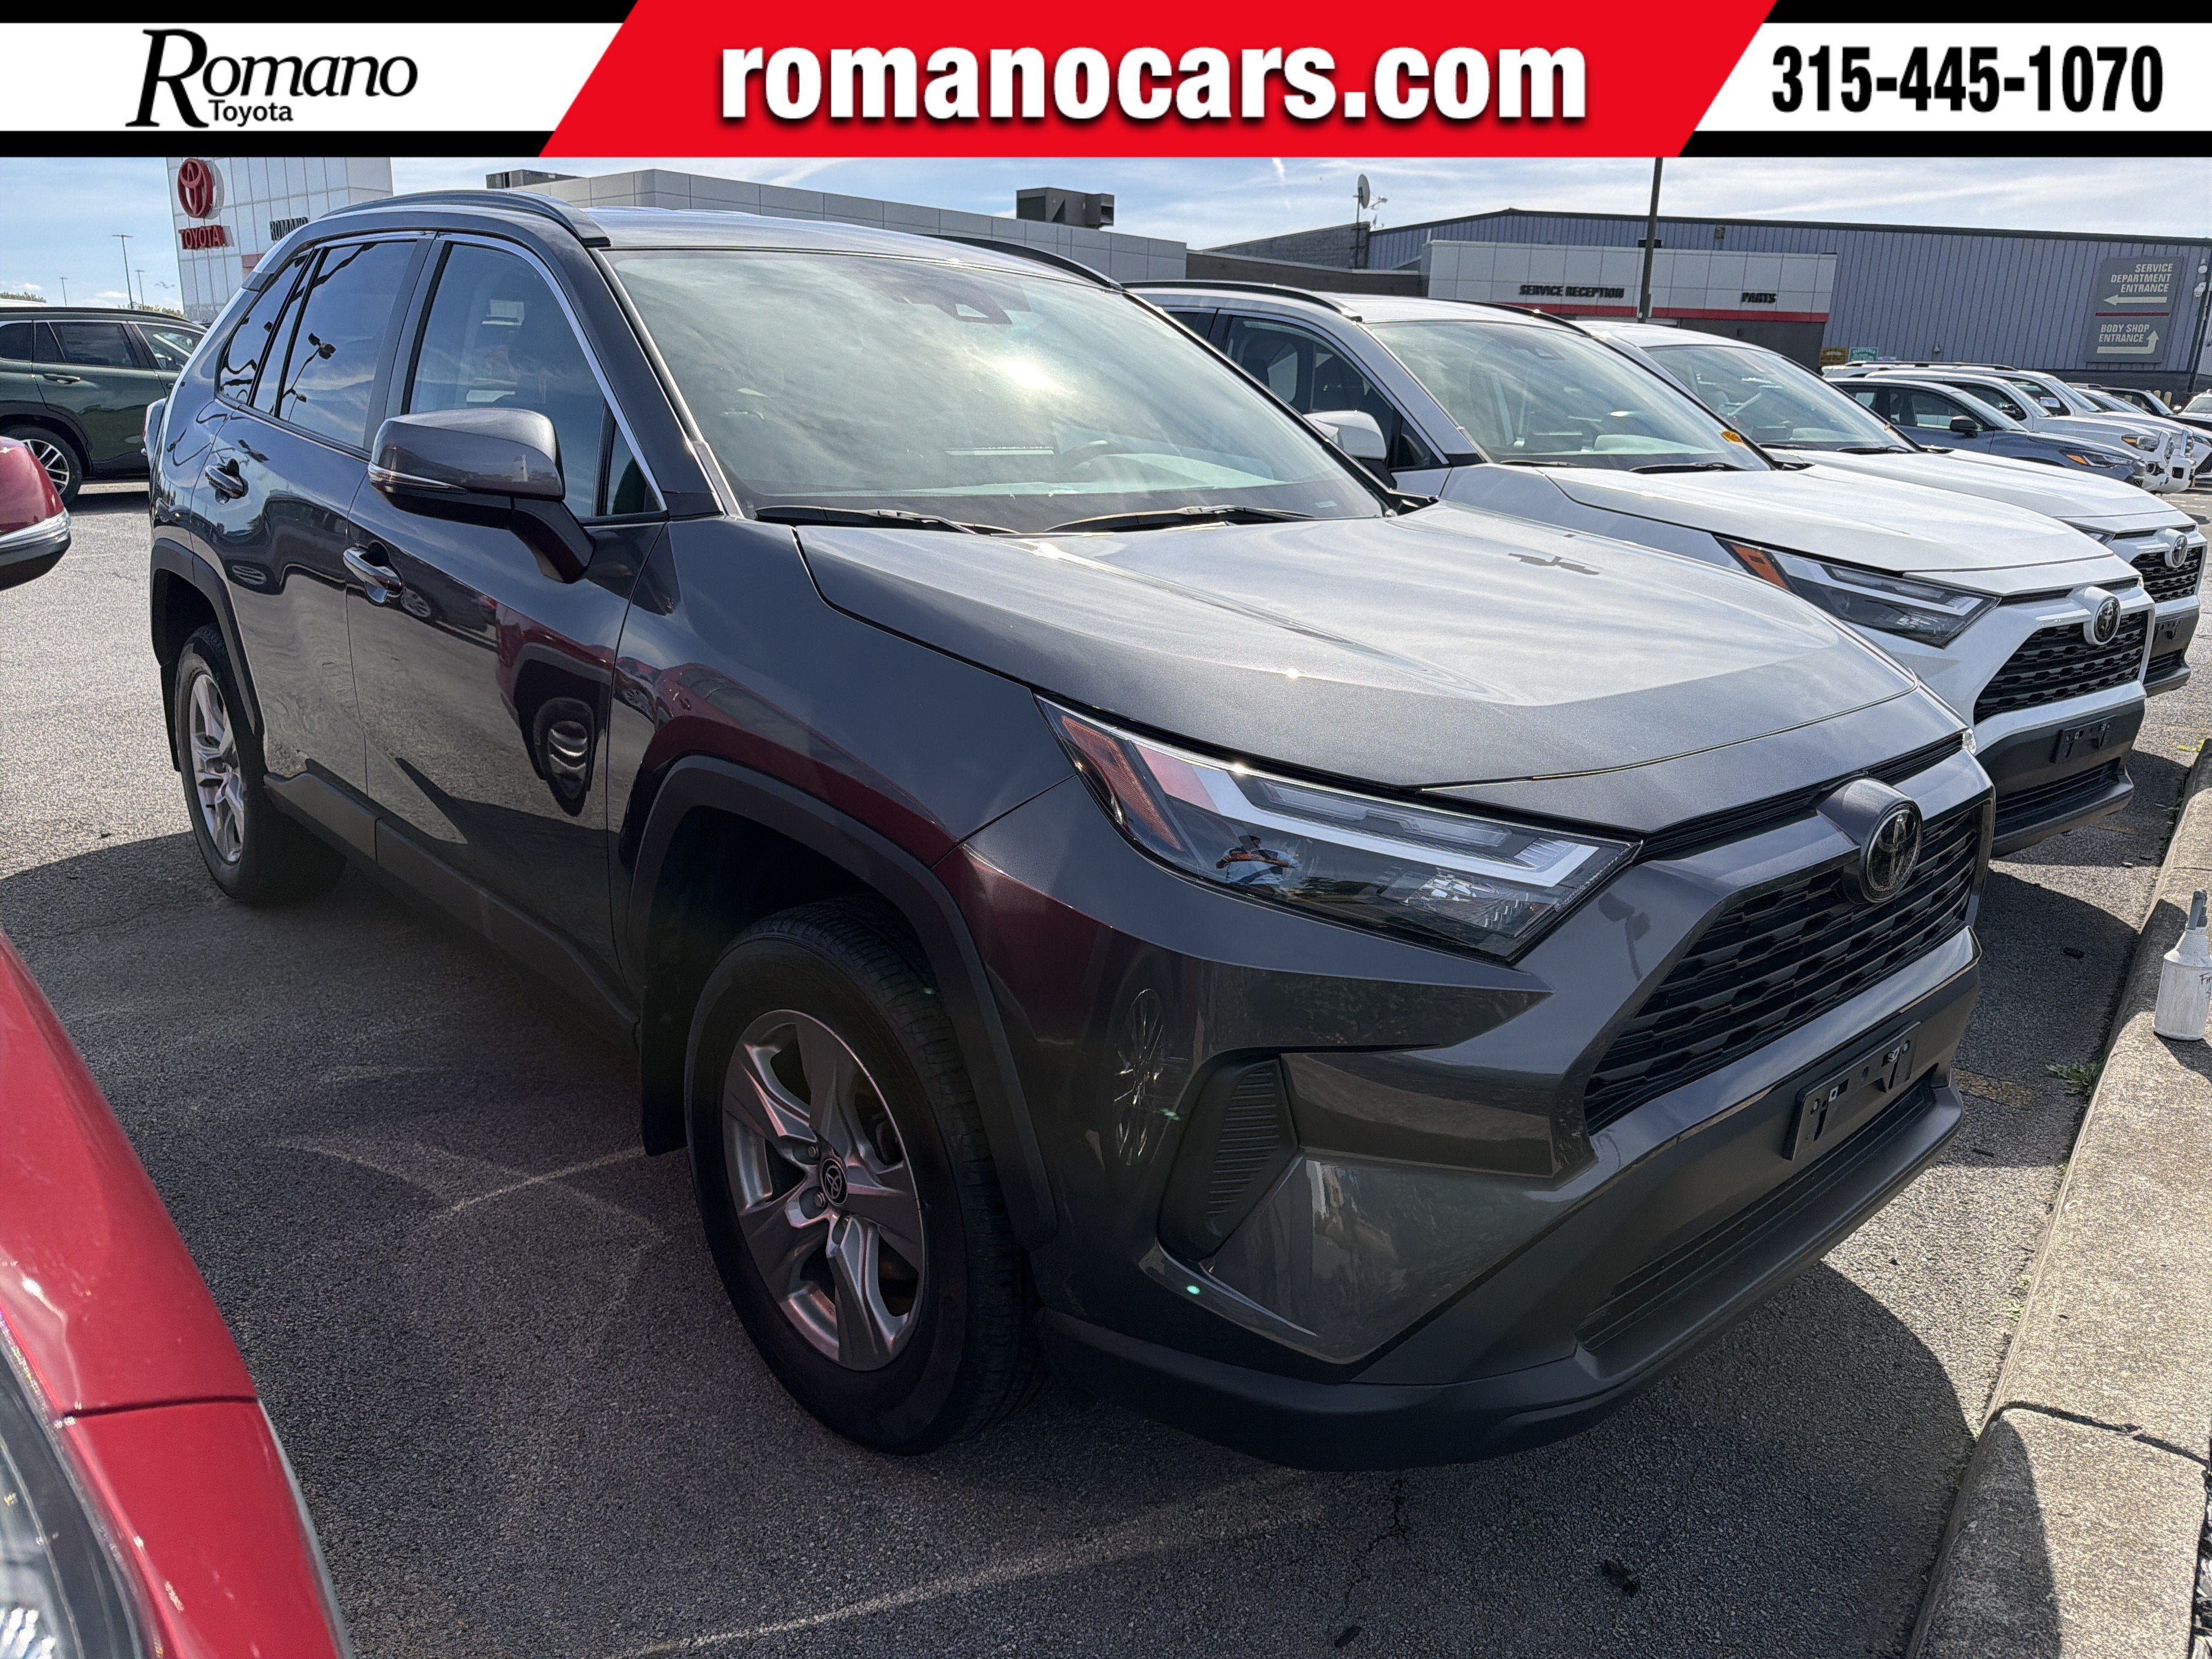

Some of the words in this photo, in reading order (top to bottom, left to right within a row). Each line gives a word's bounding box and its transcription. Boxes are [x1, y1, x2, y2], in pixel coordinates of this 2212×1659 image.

[178, 225, 226, 250] TOYOTA
[2135, 263, 2174, 273] SERVICE
[2111, 274, 2172, 283] DEPARTMENT
[1520, 285, 1564, 296] SERVICE
[1565, 286, 1624, 298] RECEPTION
[2120, 284, 2170, 293] ENTRANCE
[1741, 292, 1776, 303] PARTS
[2100, 324, 2124, 333] BODY
[2126, 324, 2150, 333] SHOP
[2098, 334, 2145, 343] ENTRANCE
